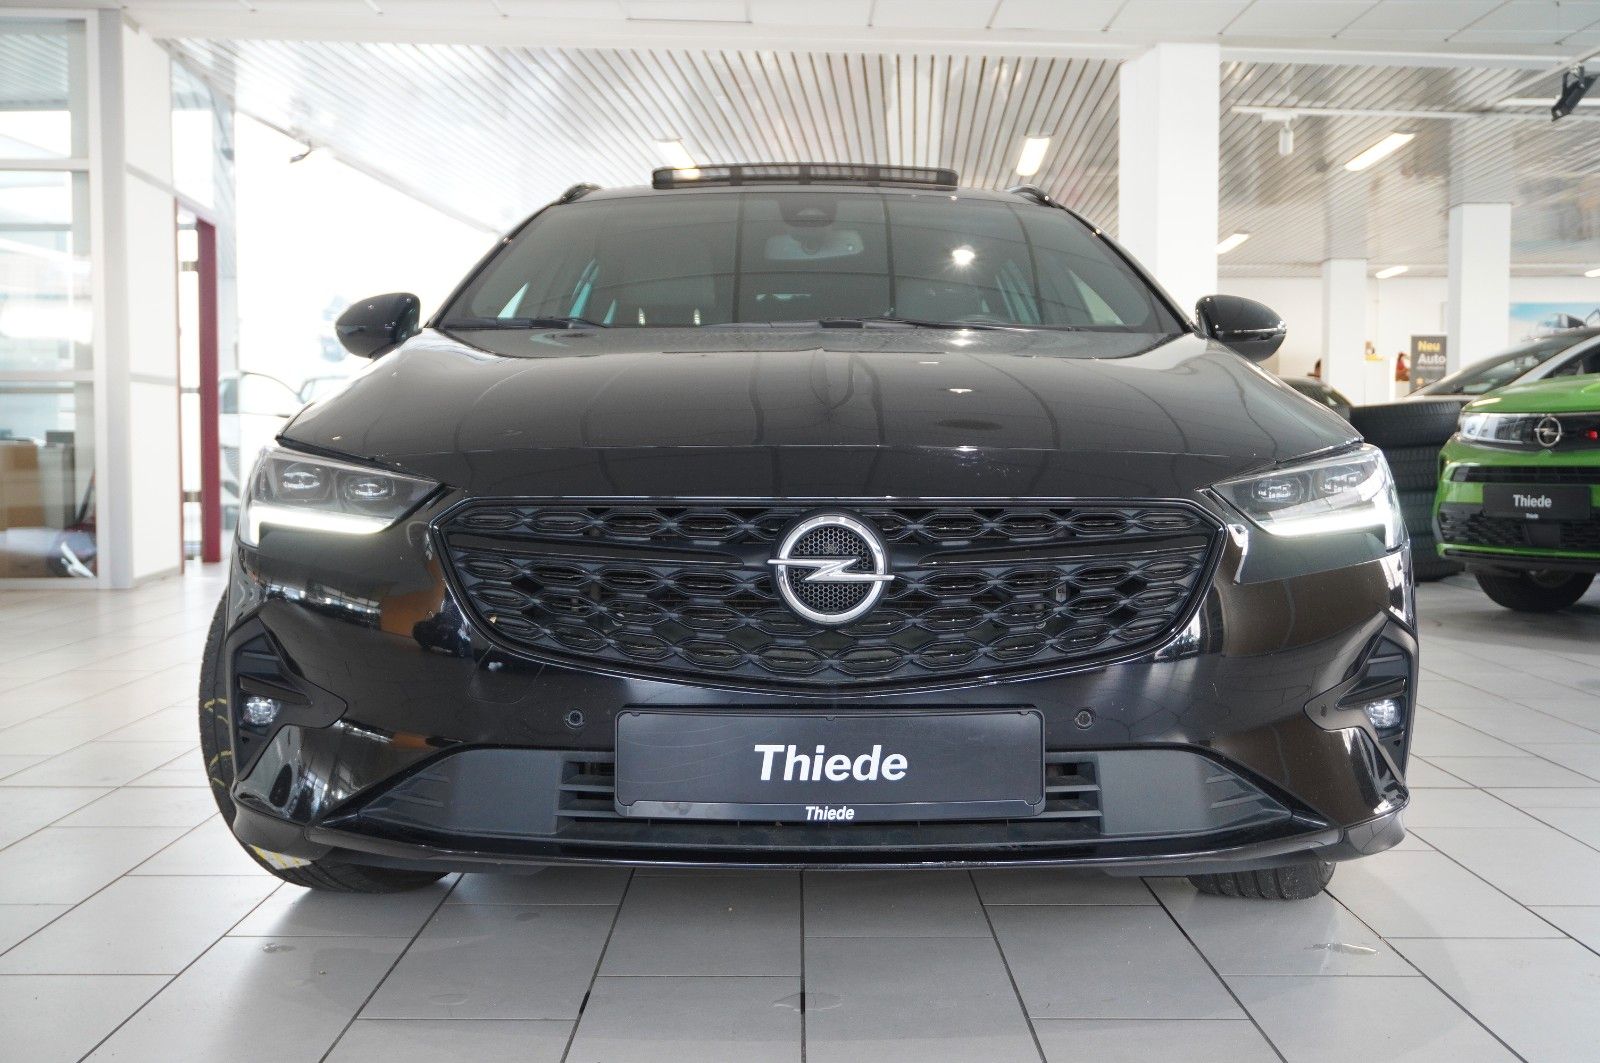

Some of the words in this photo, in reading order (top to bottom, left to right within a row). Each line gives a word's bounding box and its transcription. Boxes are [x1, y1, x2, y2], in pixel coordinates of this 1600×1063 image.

[1417, 340, 1441, 352] Neu
[1417, 353, 1446, 365] Auto
[1513, 494, 1552, 508] Thiede
[753, 744, 908, 781] Thiede
[805, 805, 855, 821] Thiede
